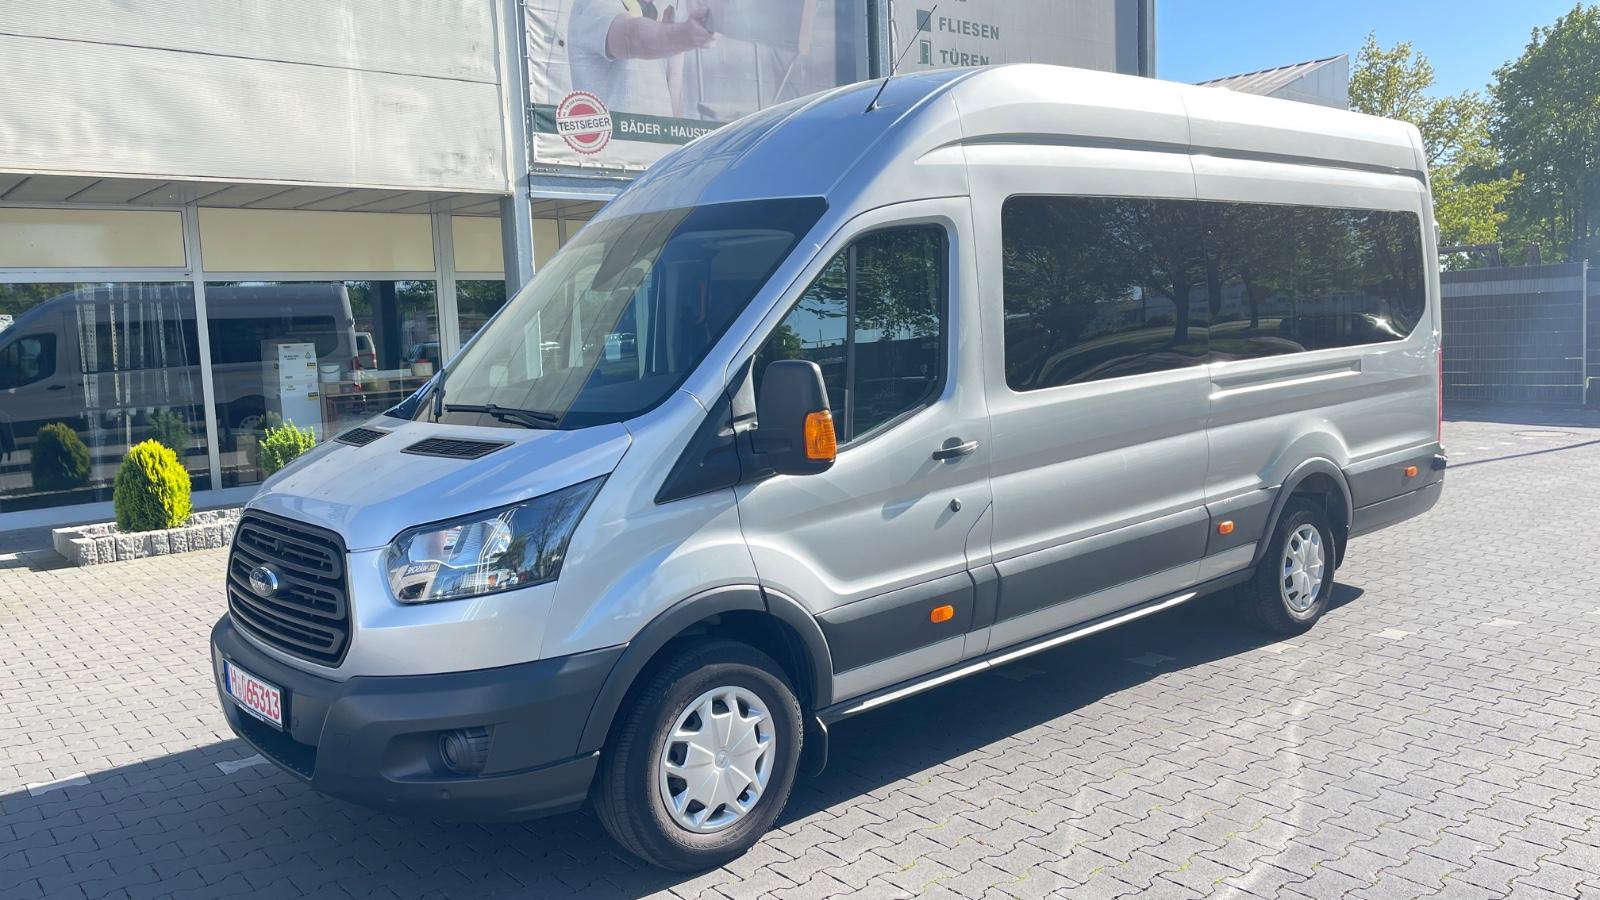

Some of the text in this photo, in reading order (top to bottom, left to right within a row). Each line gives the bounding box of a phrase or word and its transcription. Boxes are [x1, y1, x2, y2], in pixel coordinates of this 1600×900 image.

[939, 17, 999, 40] FLIESEN
[939, 48, 989, 66] TÜREN
[558, 117, 610, 132] TESTSIEGER
[620, 119, 661, 135] BÄDER
